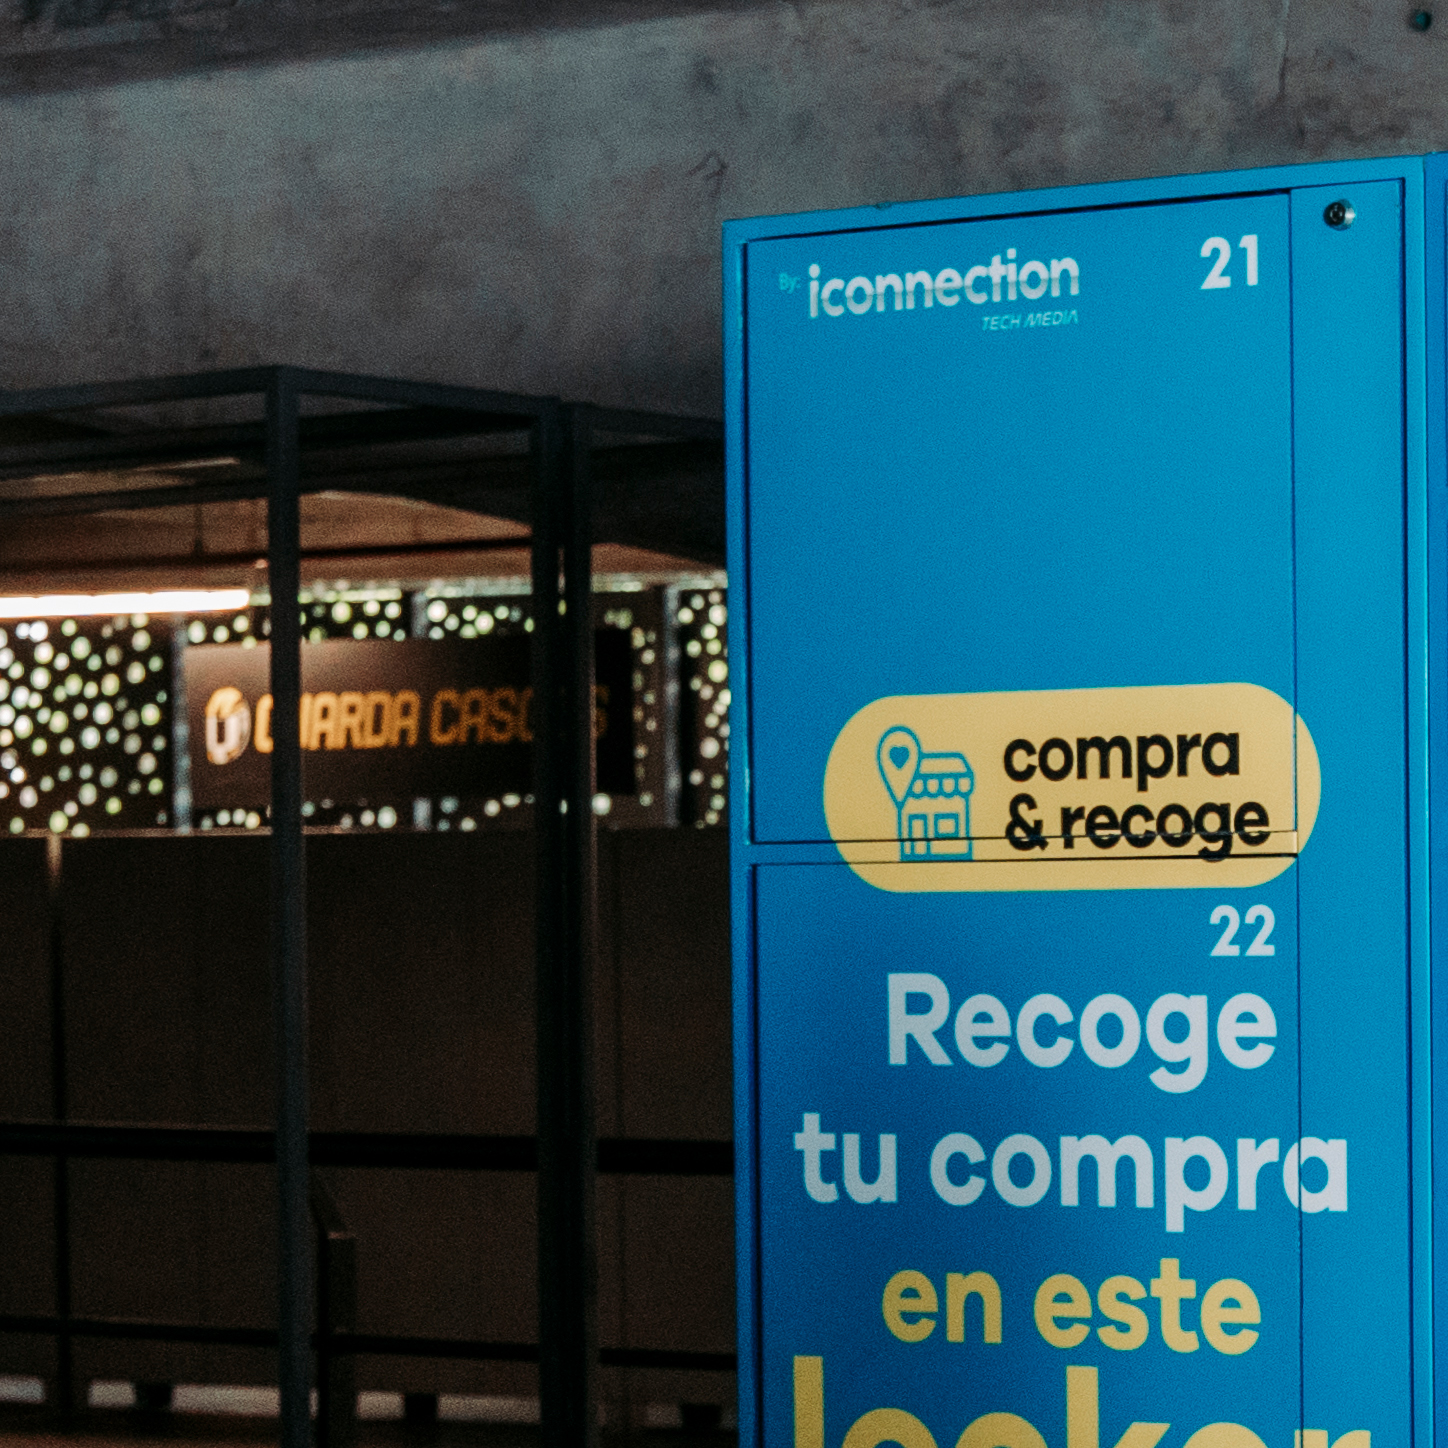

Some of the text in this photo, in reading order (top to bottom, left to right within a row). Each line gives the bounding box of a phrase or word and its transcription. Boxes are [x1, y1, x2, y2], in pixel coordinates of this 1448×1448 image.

[808, 248, 1080, 319] iconnection
[1201, 235, 1258, 289] 21
[981, 314, 1020, 332] TECH
[1004, 731, 1239, 791] compra
[1005, 793, 1270, 862] & recoge
[1210, 904, 1275, 957] 22
[887, 973, 1277, 1094] Recoge
[794, 1112, 1348, 1233] tu compra
[883, 1258, 1261, 1356] en este
